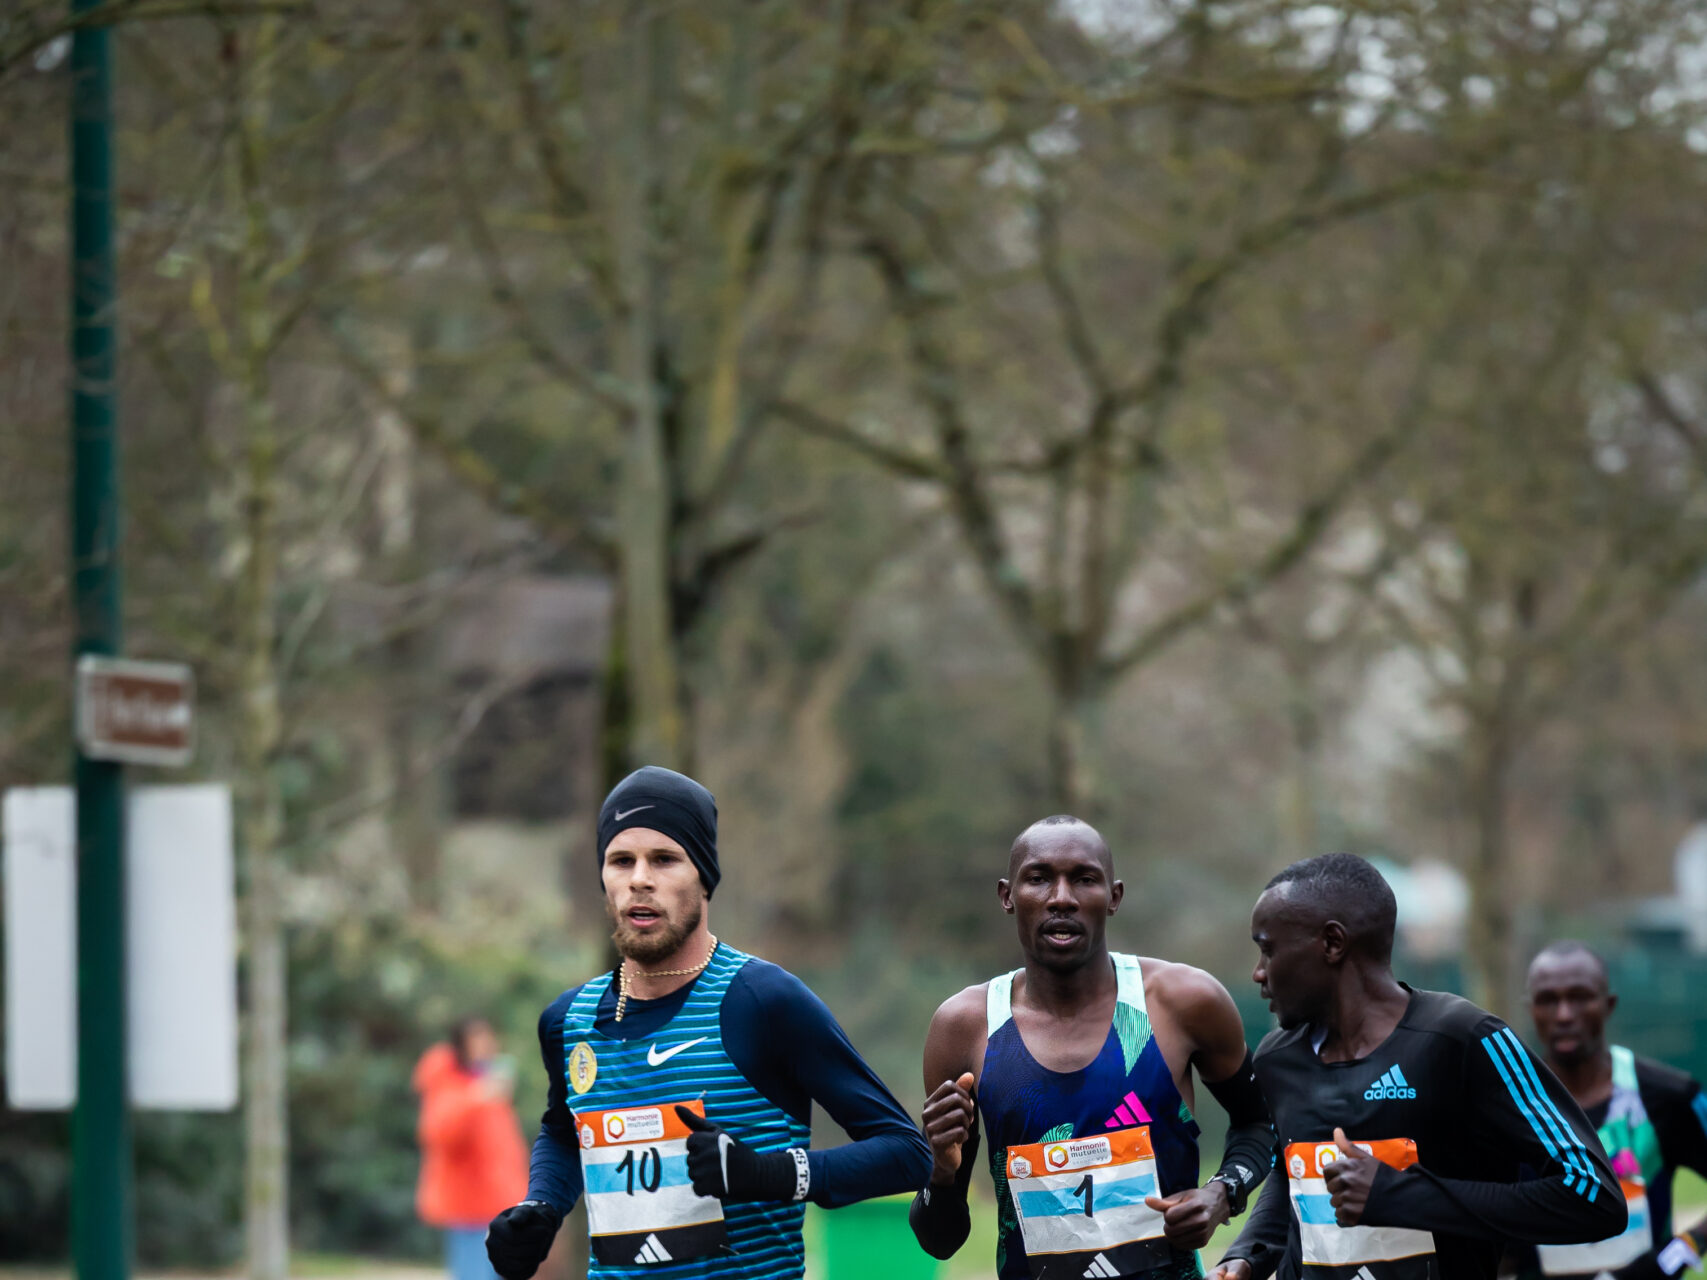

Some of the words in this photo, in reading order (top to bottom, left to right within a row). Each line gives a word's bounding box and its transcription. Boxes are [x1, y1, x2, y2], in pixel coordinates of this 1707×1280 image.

[1364, 1086, 1417, 1101] adidas
[1069, 1141, 1107, 1152] Harmonie
[1071, 1147, 1109, 1158] mutuelle
[615, 1147, 662, 1197] 10
[1073, 1174, 1094, 1218] 1
